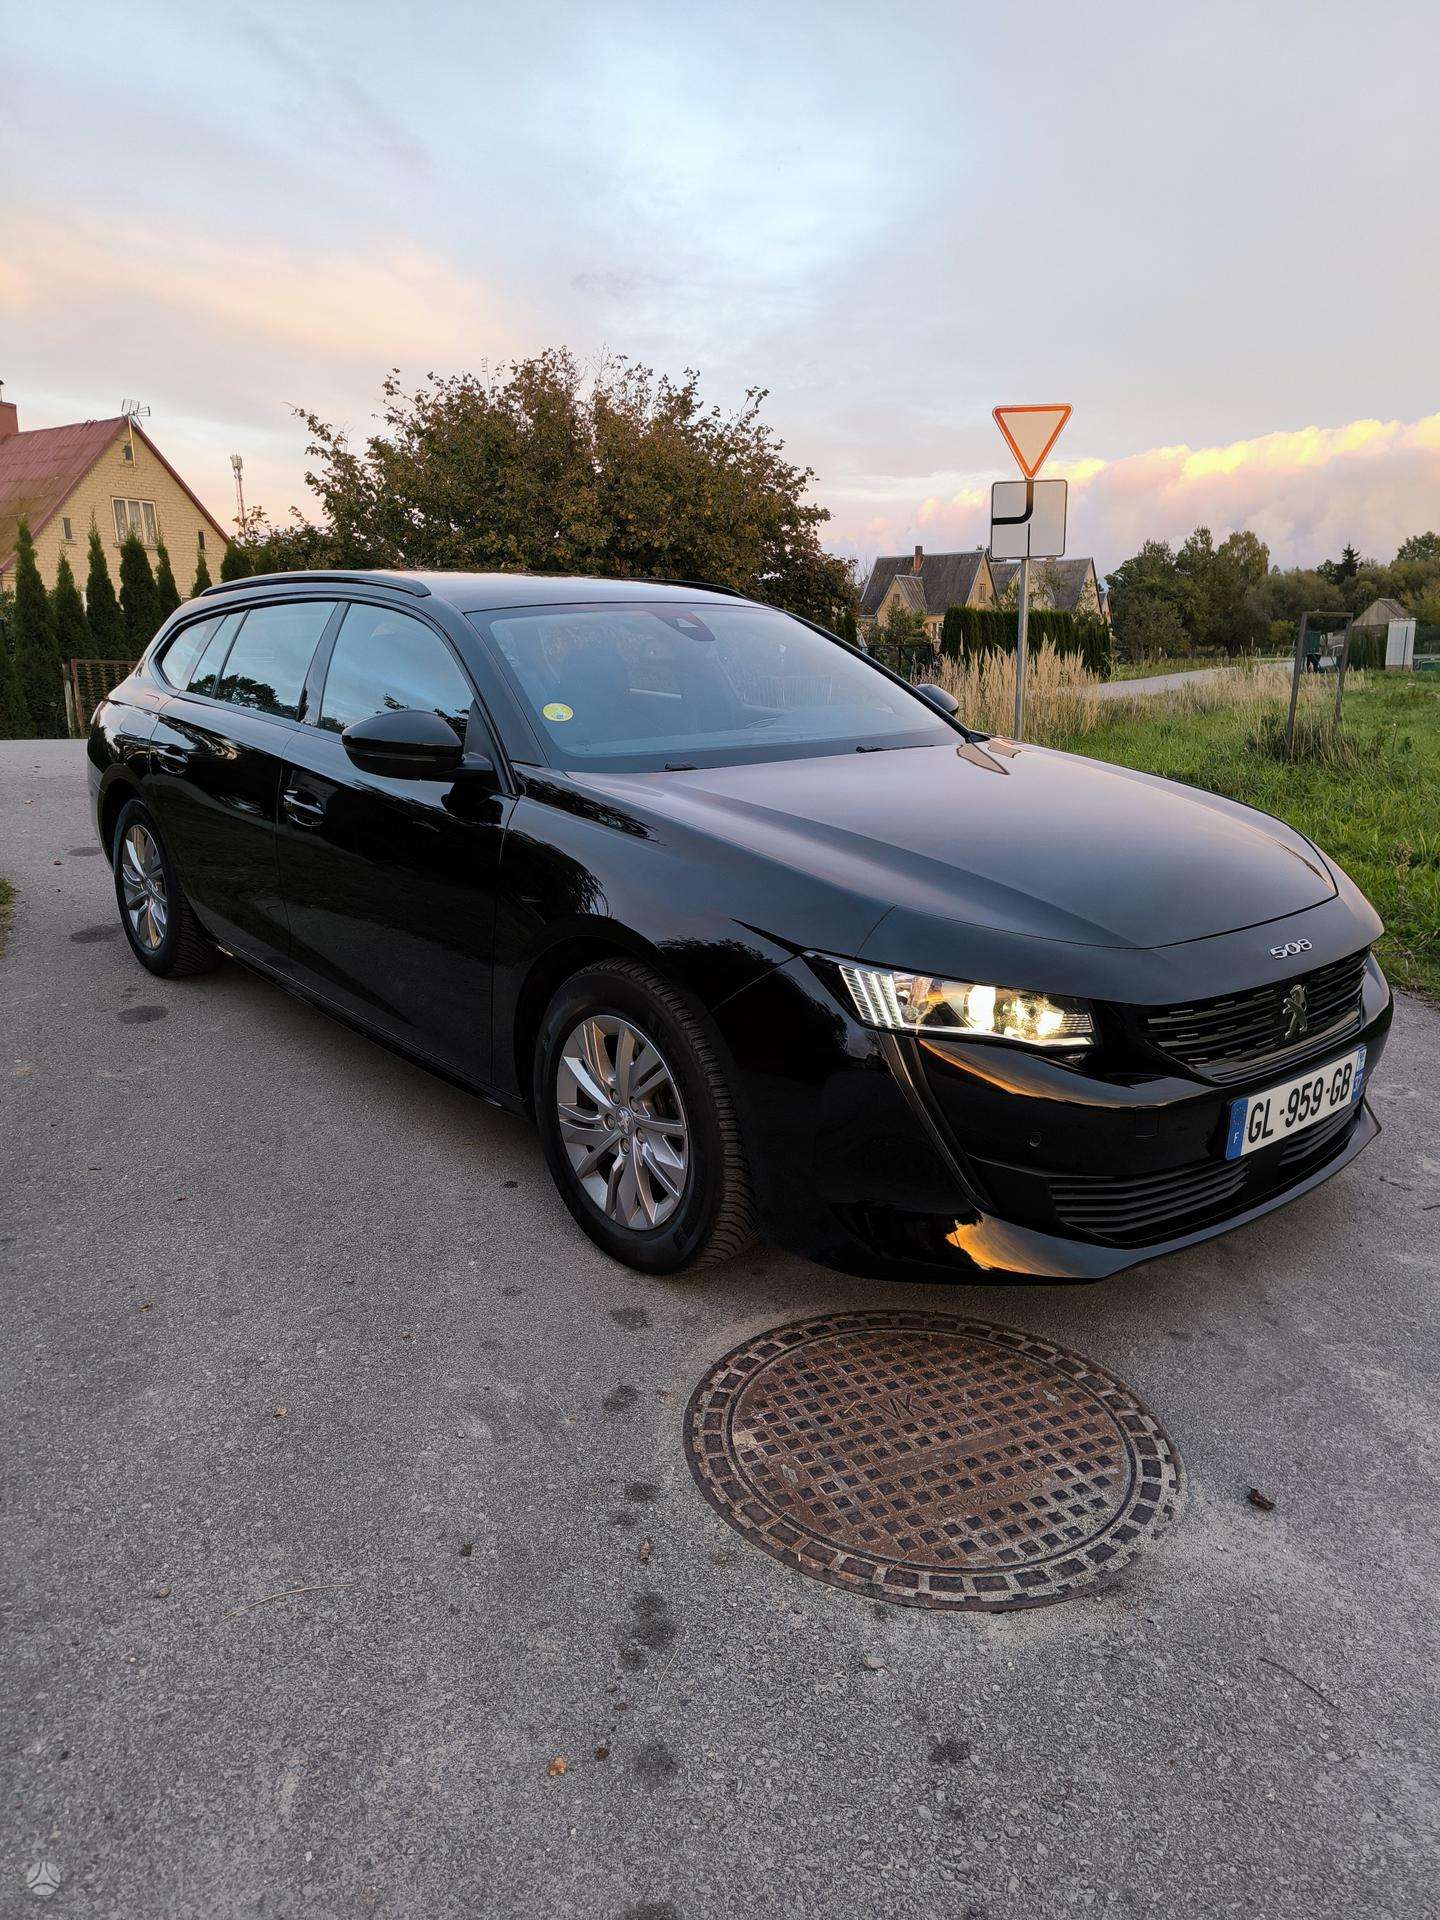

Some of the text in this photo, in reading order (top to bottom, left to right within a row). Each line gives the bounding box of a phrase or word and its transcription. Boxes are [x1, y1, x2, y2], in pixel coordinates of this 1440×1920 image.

[1270, 938, 1313, 960] 508
[1248, 1062, 1353, 1144] GL-959-GB
[1232, 1131, 1240, 1144] F
[998, 1479, 1043, 1498] D400
